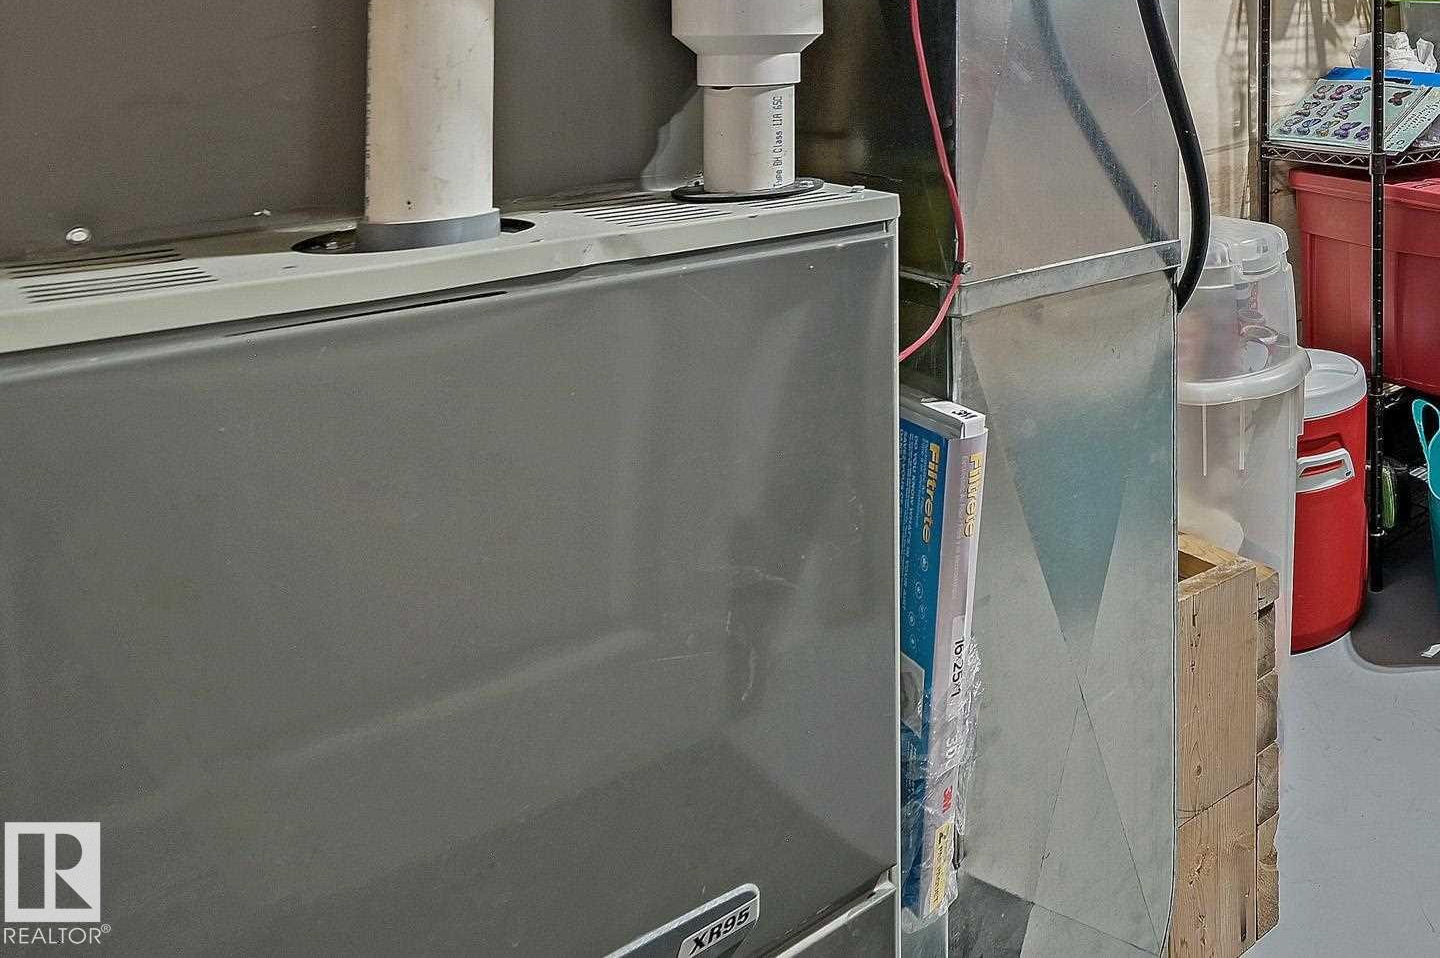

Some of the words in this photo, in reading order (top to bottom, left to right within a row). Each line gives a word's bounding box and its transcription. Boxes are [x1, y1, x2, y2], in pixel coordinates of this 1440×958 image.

[773, 131, 782, 154] Class
[922, 442, 941, 543] Filtrete
[963, 452, 984, 538] Filtrete
[690, 906, 751, 956] XR95
